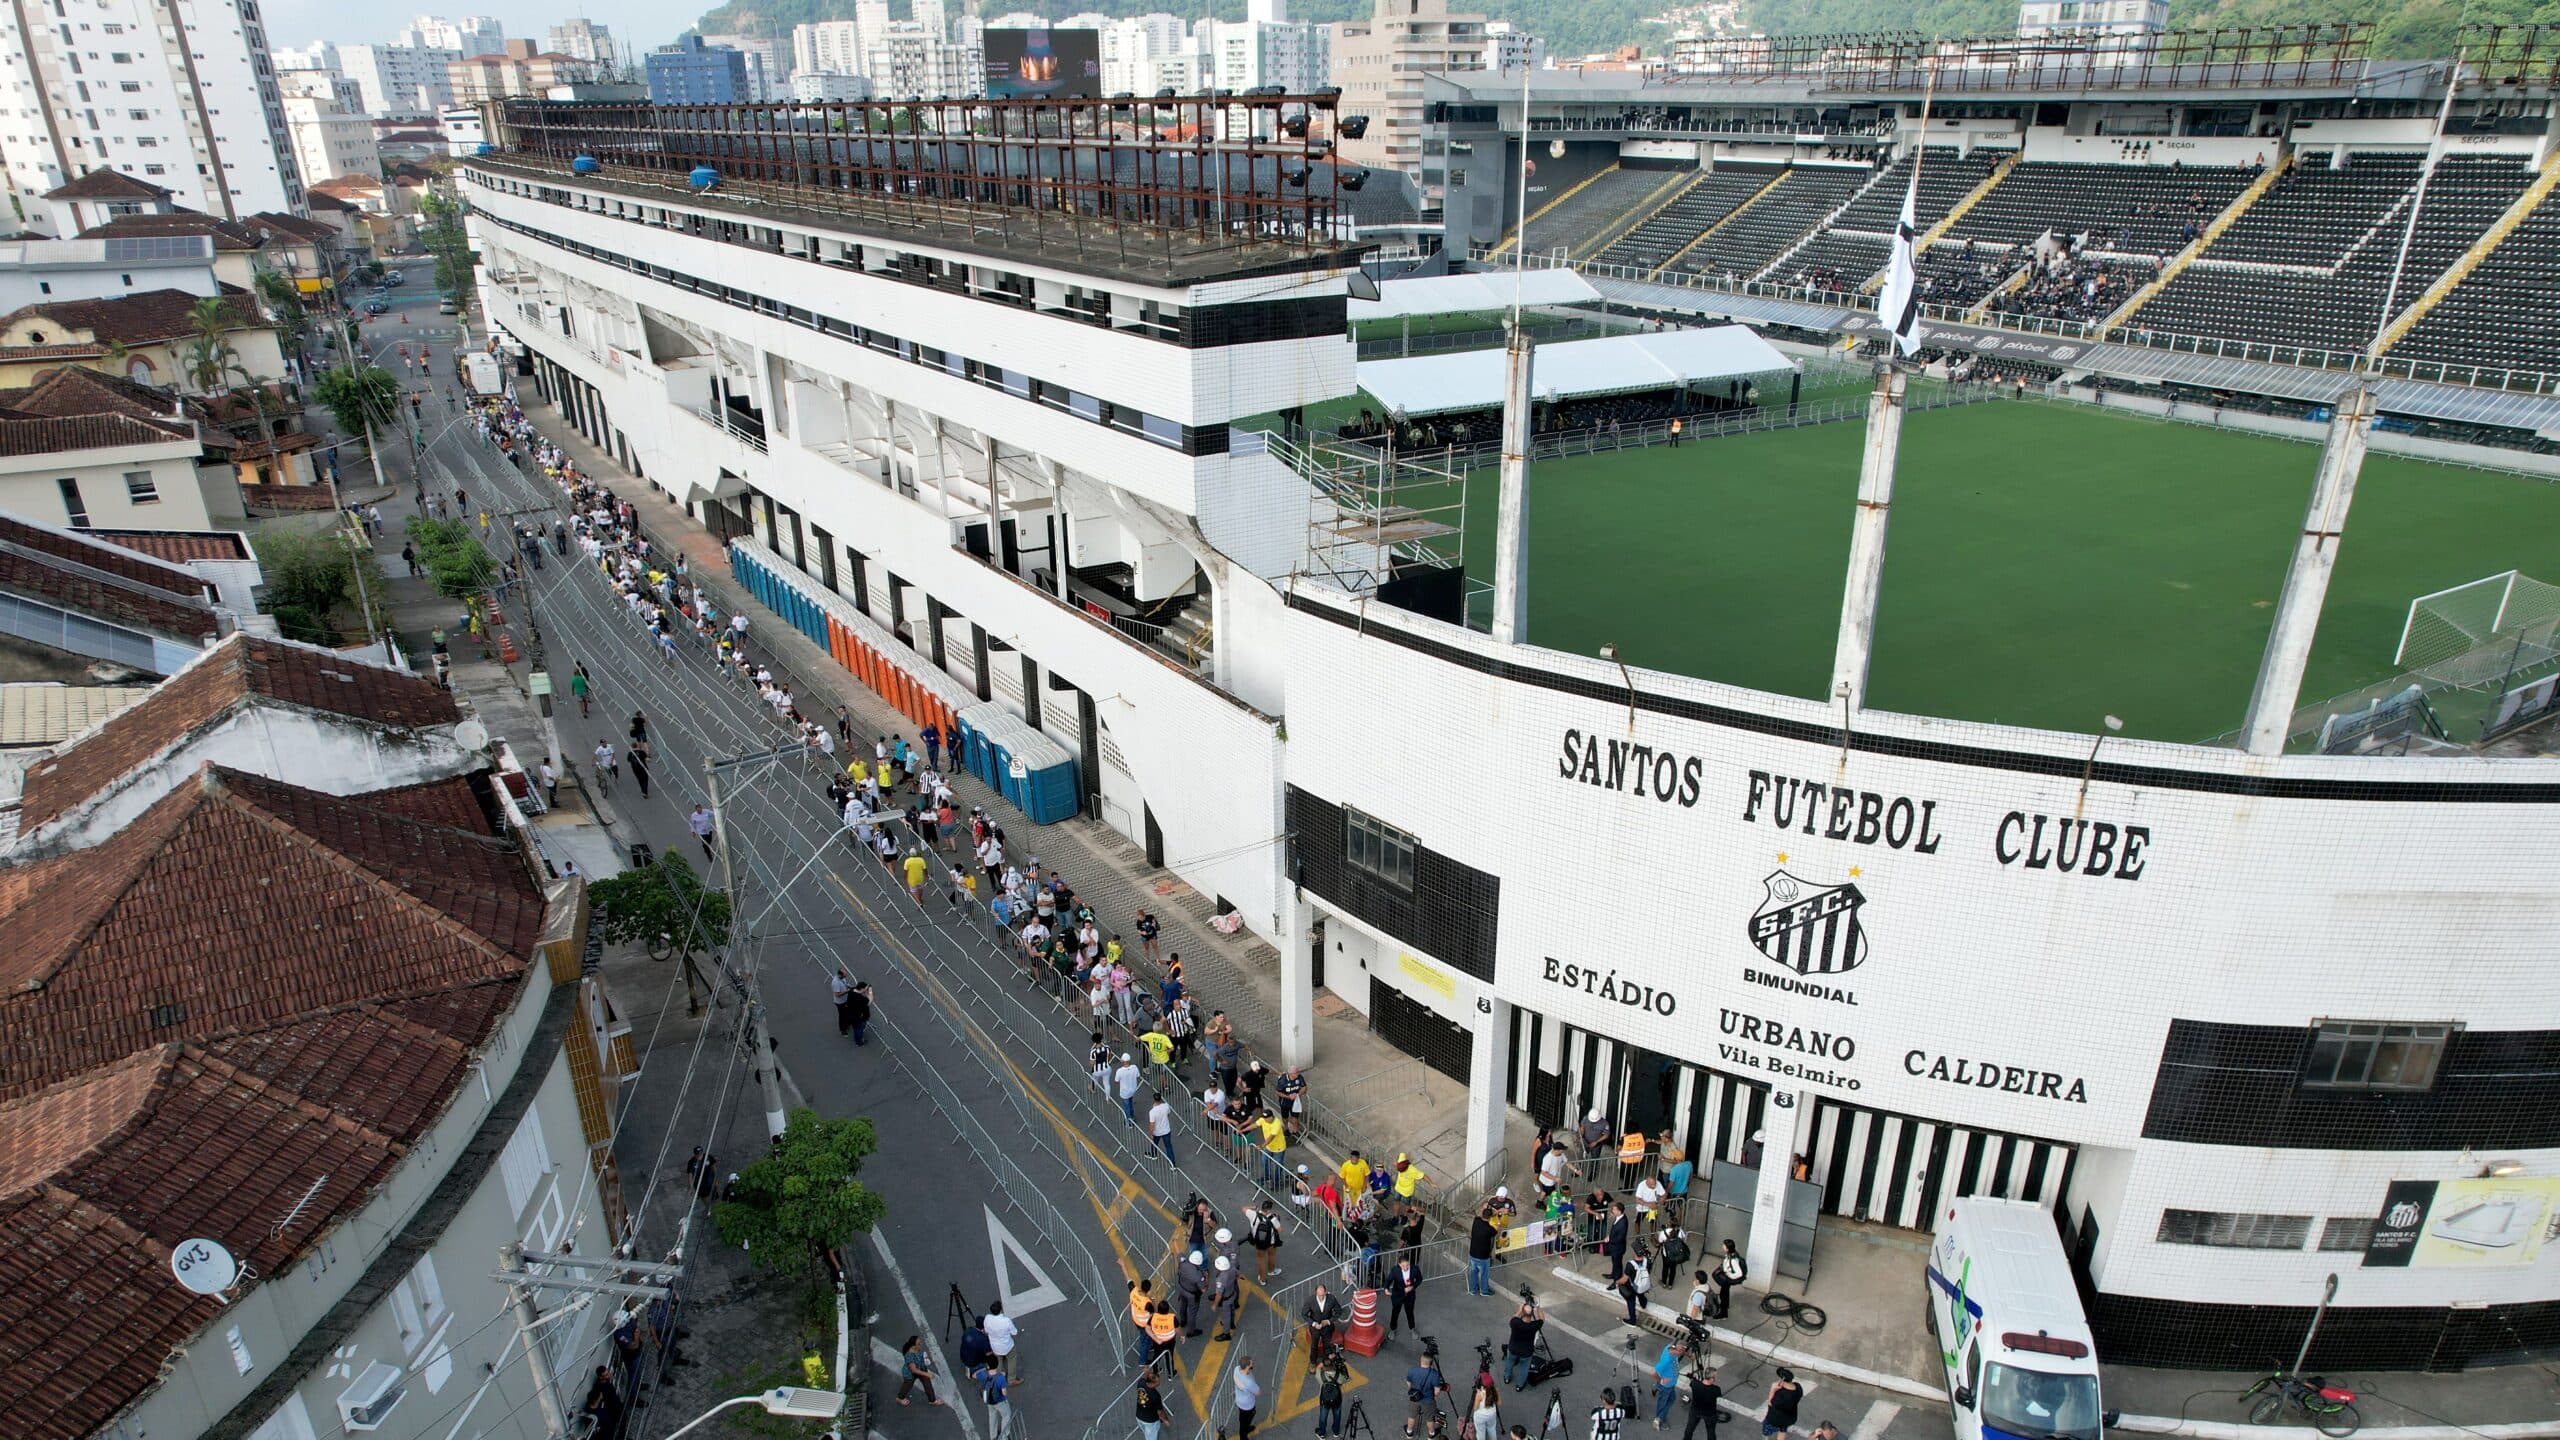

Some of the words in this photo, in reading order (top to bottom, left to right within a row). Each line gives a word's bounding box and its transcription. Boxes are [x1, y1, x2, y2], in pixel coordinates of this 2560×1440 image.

[1931, 331, 1976, 343] pixbet
[2002, 341, 2049, 353] pixbet
[1559, 728, 1703, 809] SANTOS
[1743, 769, 1942, 855] FUTEBOL
[1995, 810, 2150, 881] CLUBE
[1757, 890, 1853, 938] S.F.C.
[1743, 967, 1859, 1006] BIMUNDIAL
[1152, 1041, 1163, 1051] 10
[1543, 956, 1676, 1017] ESTÁDIO
[1719, 1007, 1856, 1062] URBANO
[1904, 1049, 2087, 1104] CALDEIRA
[1718, 1043, 1760, 1069] Vila
[1766, 1056, 1861, 1091] Belmiro
[178, 1243, 205, 1272] GVT
